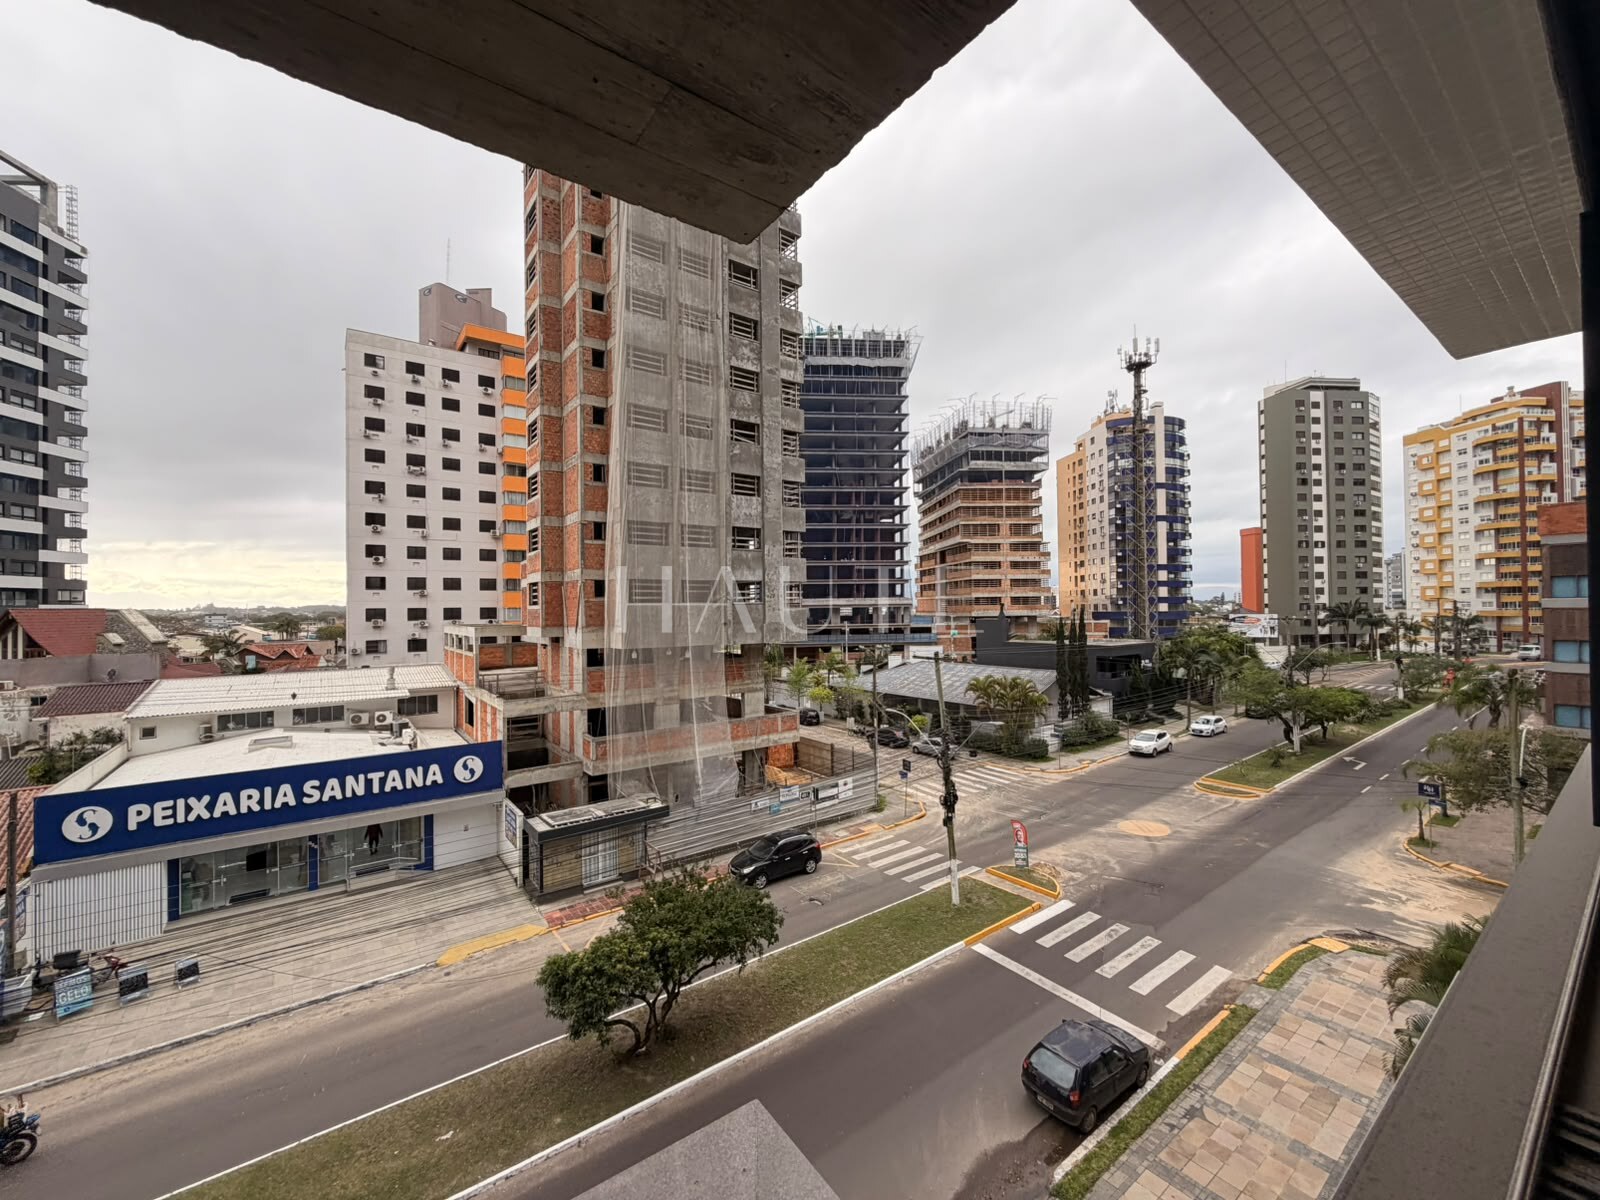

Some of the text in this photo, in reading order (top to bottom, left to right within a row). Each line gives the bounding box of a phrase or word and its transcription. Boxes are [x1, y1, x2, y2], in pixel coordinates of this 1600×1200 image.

[127, 784, 296, 831] PEIXARIA
[302, 763, 443, 805] SANTANA
[59, 985, 89, 1004] GELO
